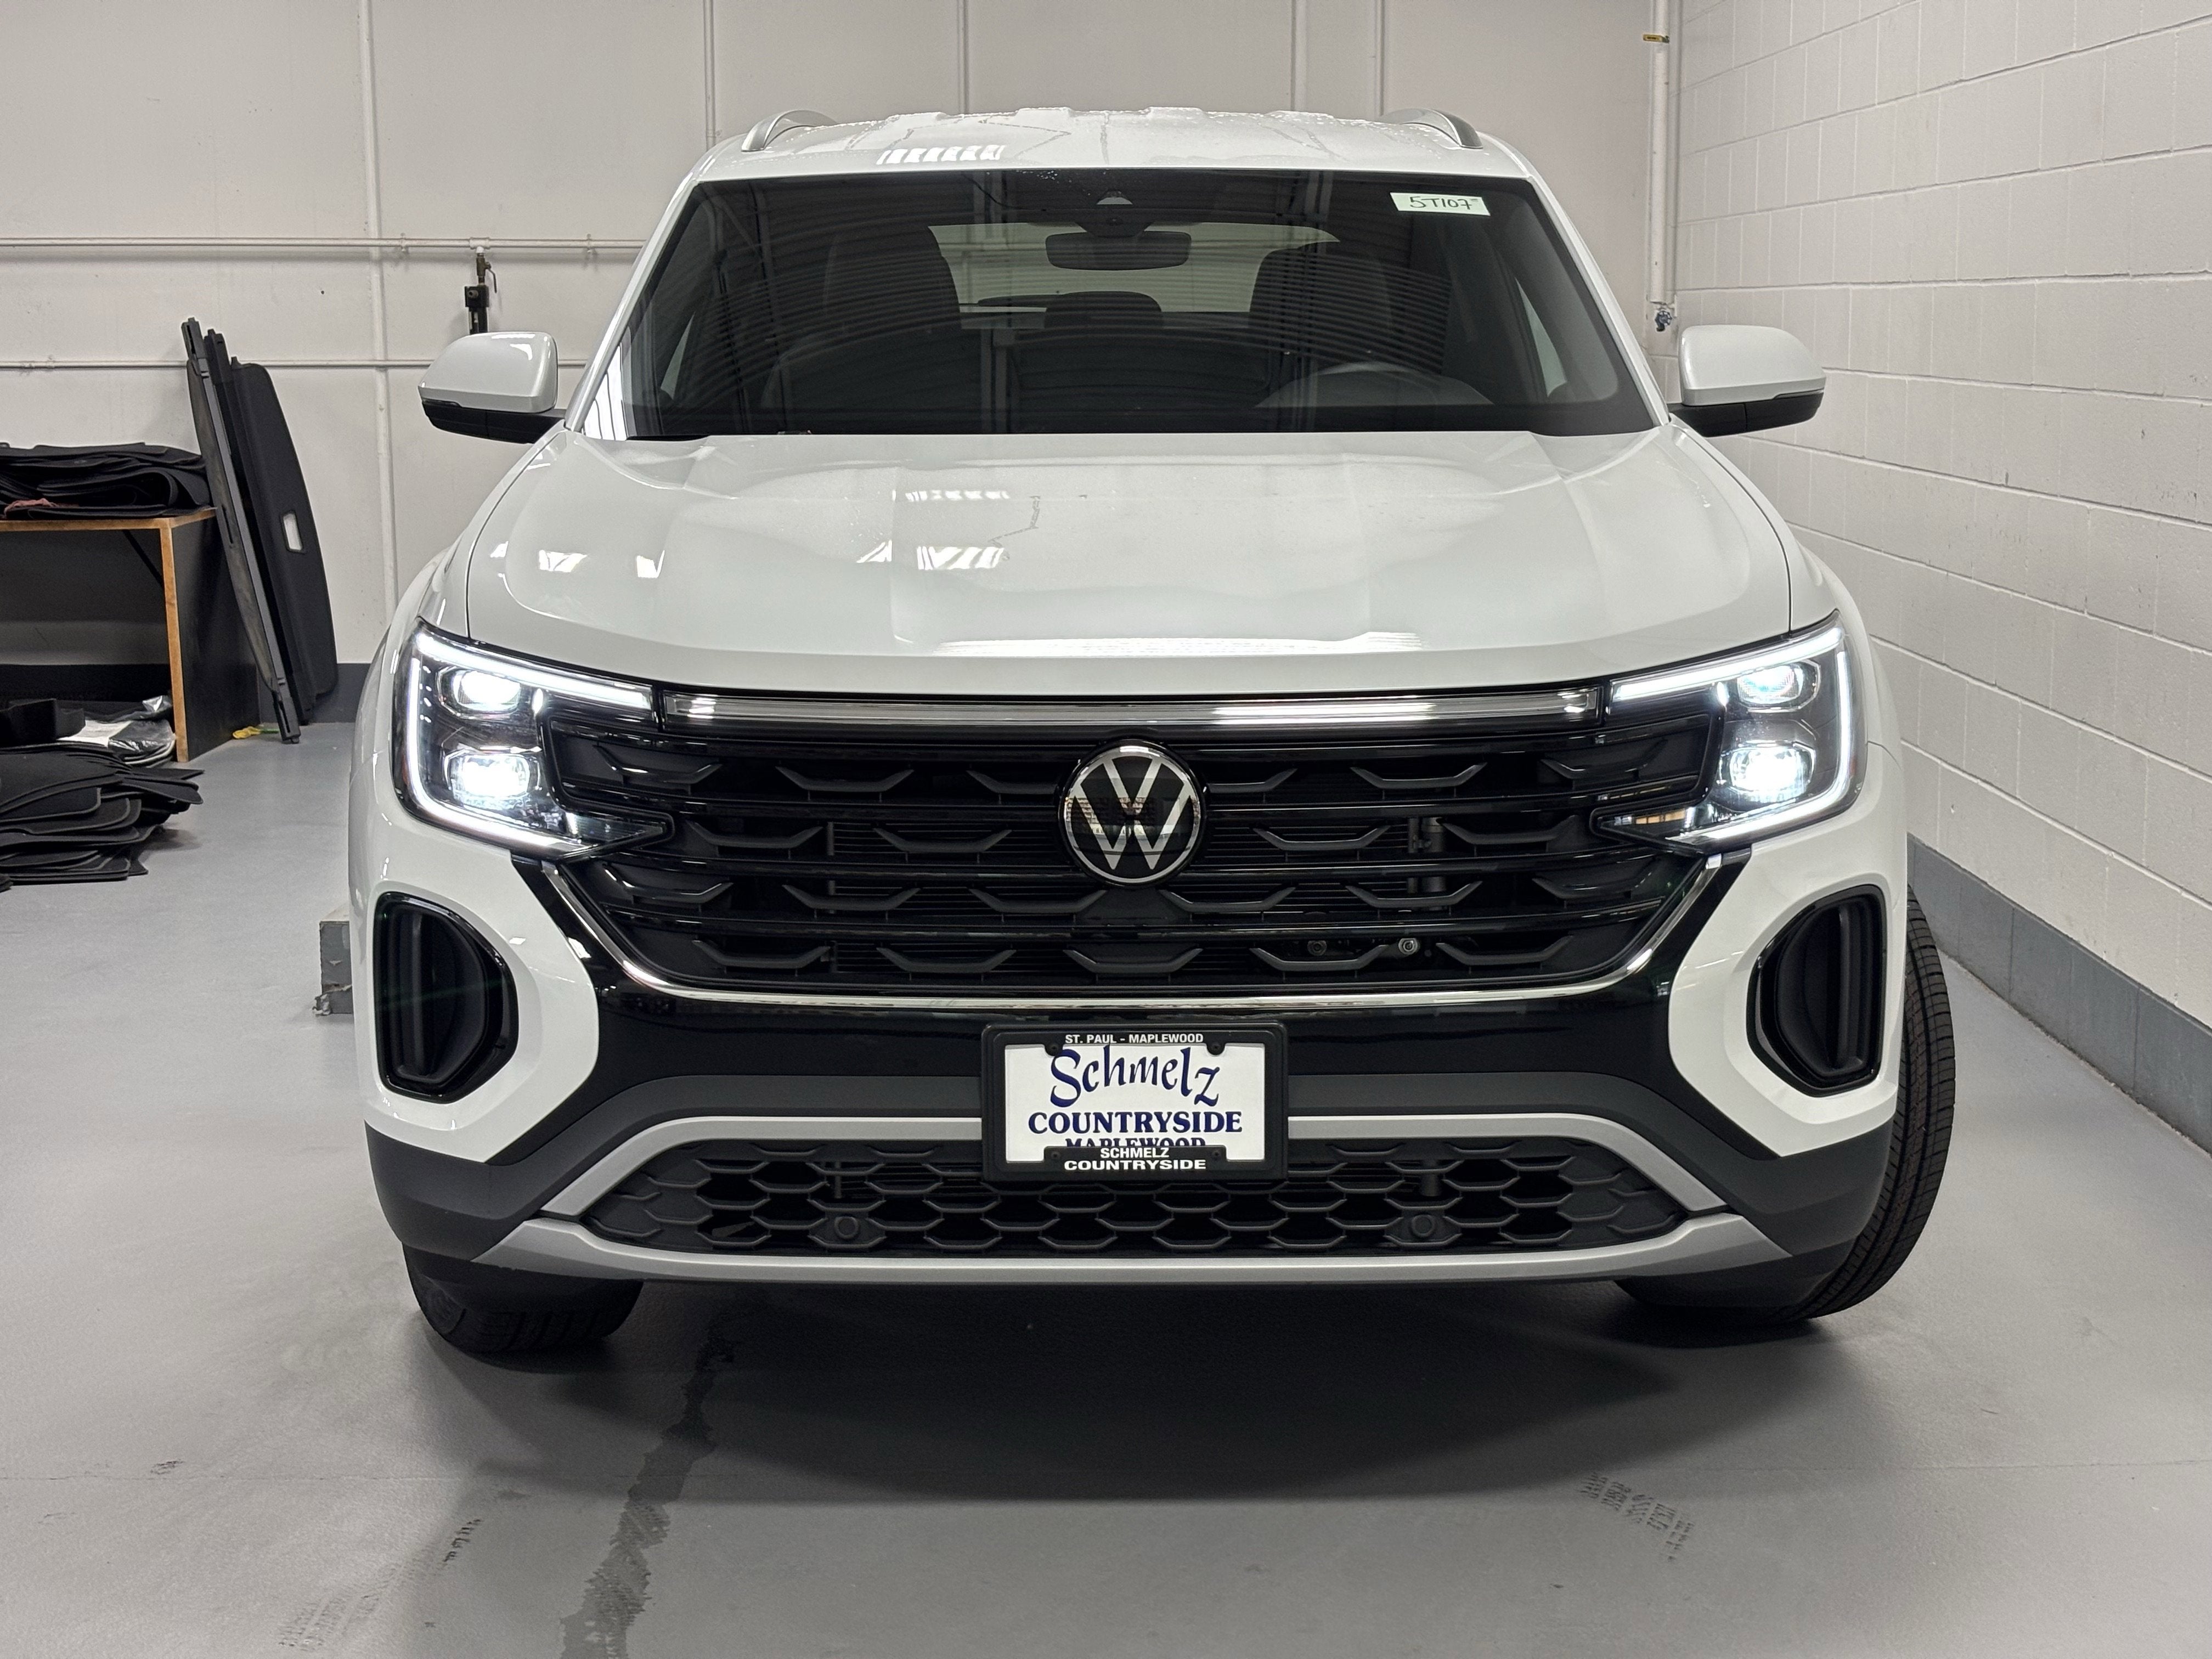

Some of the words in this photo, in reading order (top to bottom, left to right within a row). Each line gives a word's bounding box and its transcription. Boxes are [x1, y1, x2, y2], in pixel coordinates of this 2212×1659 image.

[1409, 196, 1472, 210] 5T107
[1065, 1034, 1084, 1044] ST.
[1086, 1034, 1117, 1044] PAUL
[1128, 1033, 1204, 1044] MAPLEWOOD
[1050, 1043, 1221, 1108] Schmelz
[1028, 1111, 1243, 1135] COUNTRYSIDE
[1100, 1147, 1170, 1159] SCHMELZ
[1064, 1159, 1207, 1171] COUNTRYSIDE
